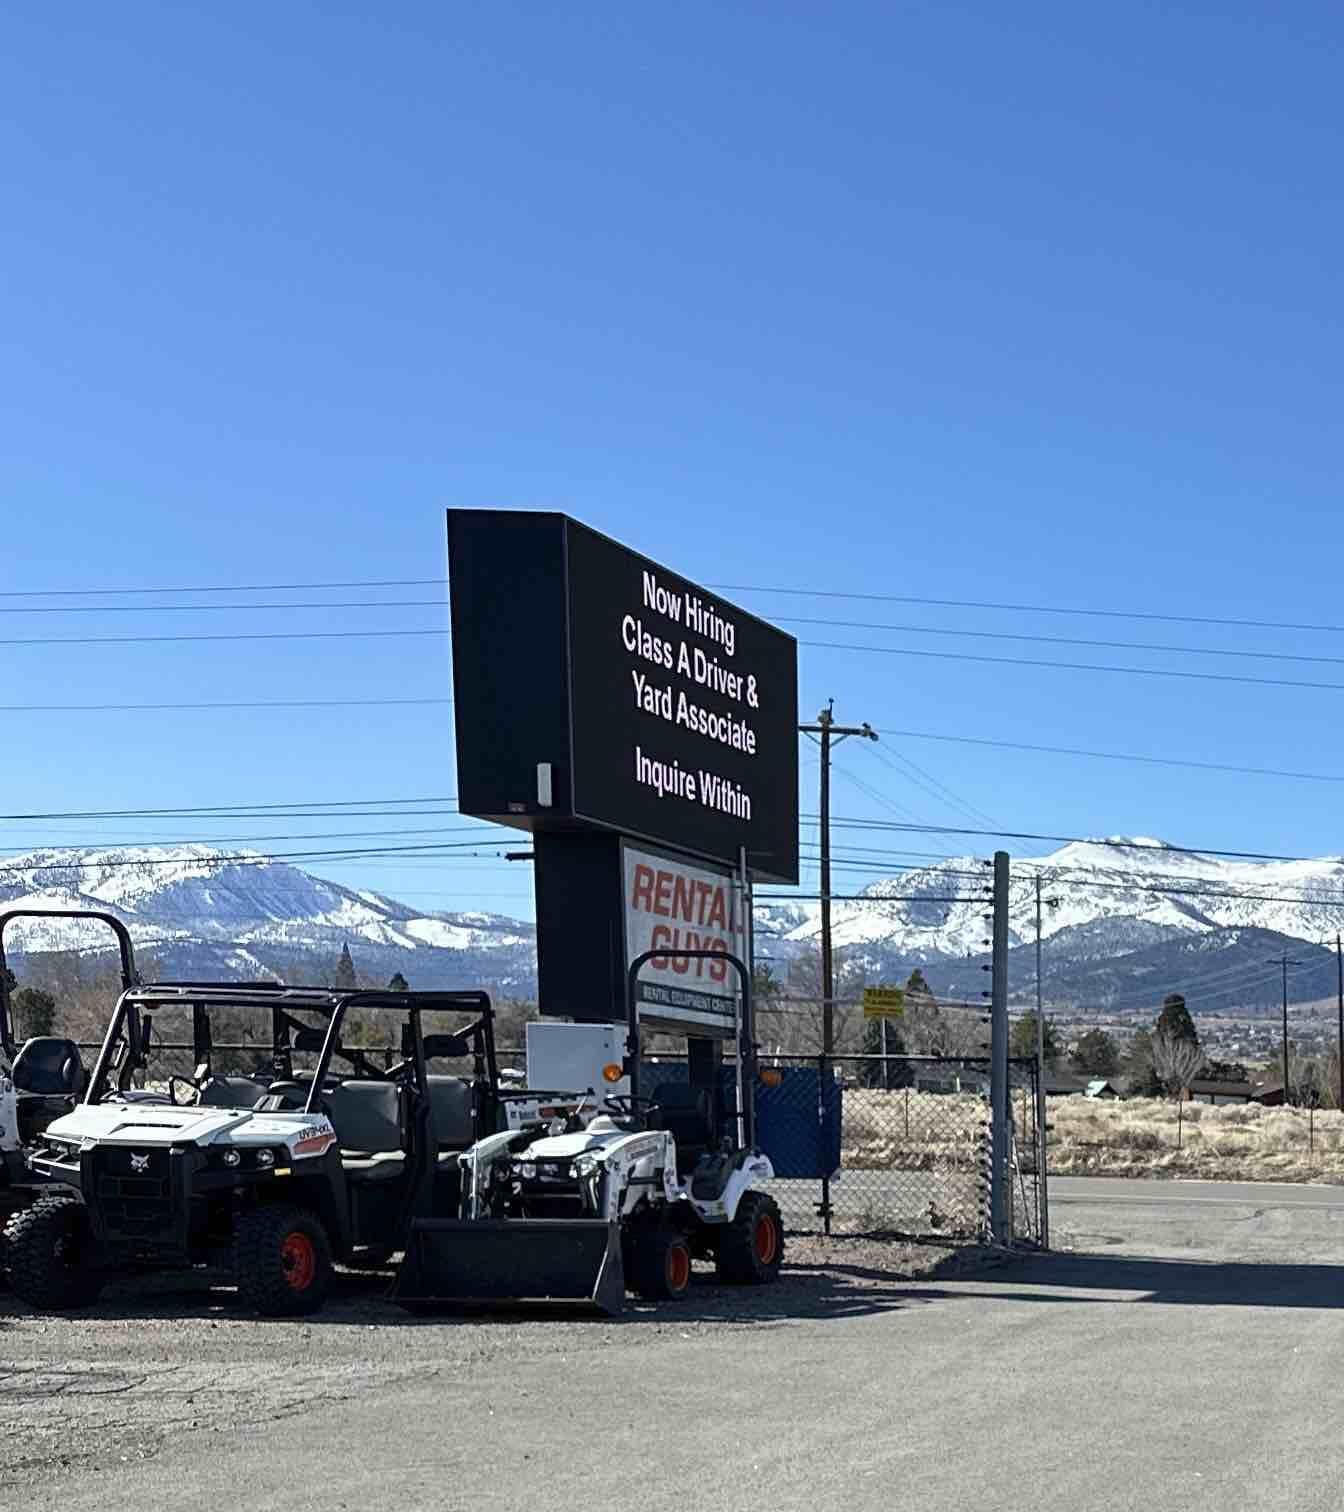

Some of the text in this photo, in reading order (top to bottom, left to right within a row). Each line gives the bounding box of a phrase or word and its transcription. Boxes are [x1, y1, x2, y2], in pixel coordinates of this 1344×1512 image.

[643, 571, 735, 656] Now Hiring
[622, 615, 759, 708] Class A Driver &
[632, 670, 756, 754] Yard Associate
[636, 746, 751, 820] Inquire Within
[650, 923, 729, 983] GUYS
[712, 998, 737, 1014] CENTE
